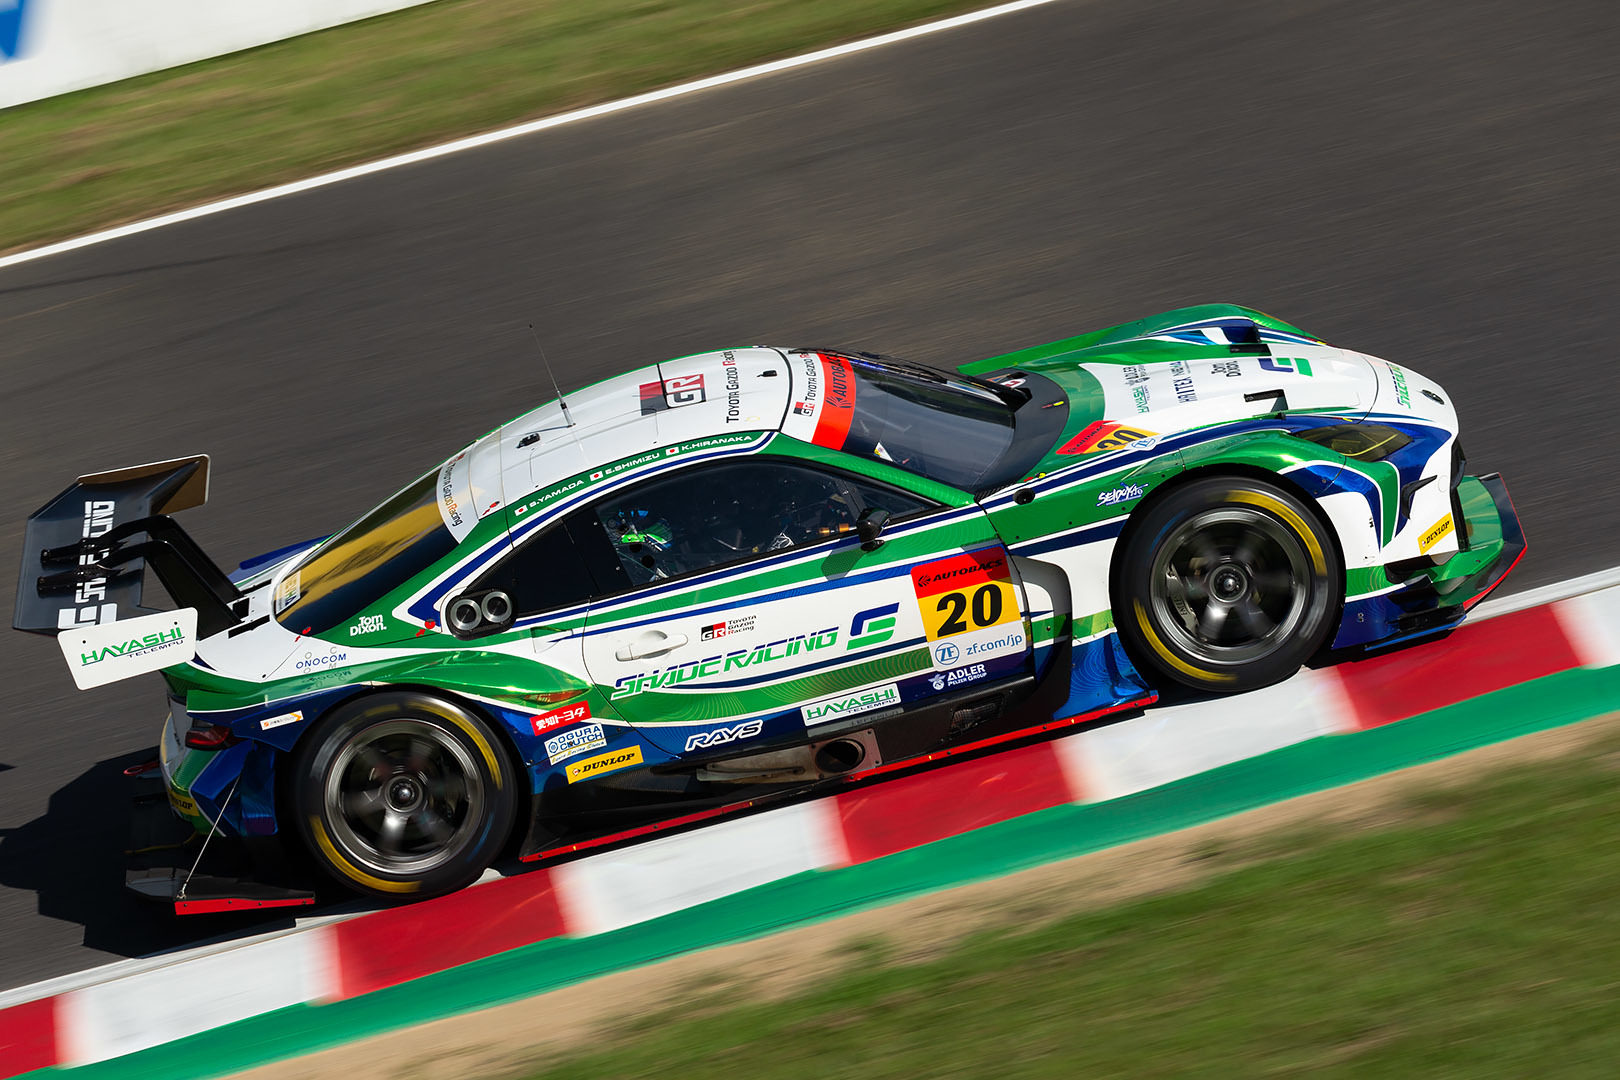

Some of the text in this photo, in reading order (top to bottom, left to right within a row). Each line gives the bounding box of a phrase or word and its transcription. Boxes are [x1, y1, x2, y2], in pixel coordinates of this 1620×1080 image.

[725, 365, 740, 390] GAZOO
[804, 379, 817, 401] TOYOTA
[727, 389, 740, 424] TOYOTA
[680, 435, 753, 452] K.HIRANAKA
[446, 502, 463, 528] Racing
[1425, 519, 1451, 546] DUNLOP
[932, 558, 1003, 582] AUTOBACS
[358, 613, 384, 628] Tom
[727, 614, 757, 625] TOYOTA
[936, 583, 1003, 638] 20
[727, 620, 755, 630] GAZOO
[727, 625, 755, 635] Racing
[80, 627, 184, 665] HAYASHI
[127, 639, 185, 659] TELEMPU
[966, 633, 1023, 656] zf.com/jp
[295, 652, 348, 669] ONOCOM
[946, 664, 986, 682] ADLER
[806, 687, 898, 720] HAYASHI
[845, 698, 897, 715] TELEMPU
[534, 706, 586, 731] 愛知トヨタ
[557, 725, 602, 744] OGURA
[559, 731, 603, 751] CLUTCH
[685, 719, 765, 753] RAYS
[581, 752, 636, 773] DUNLOP
